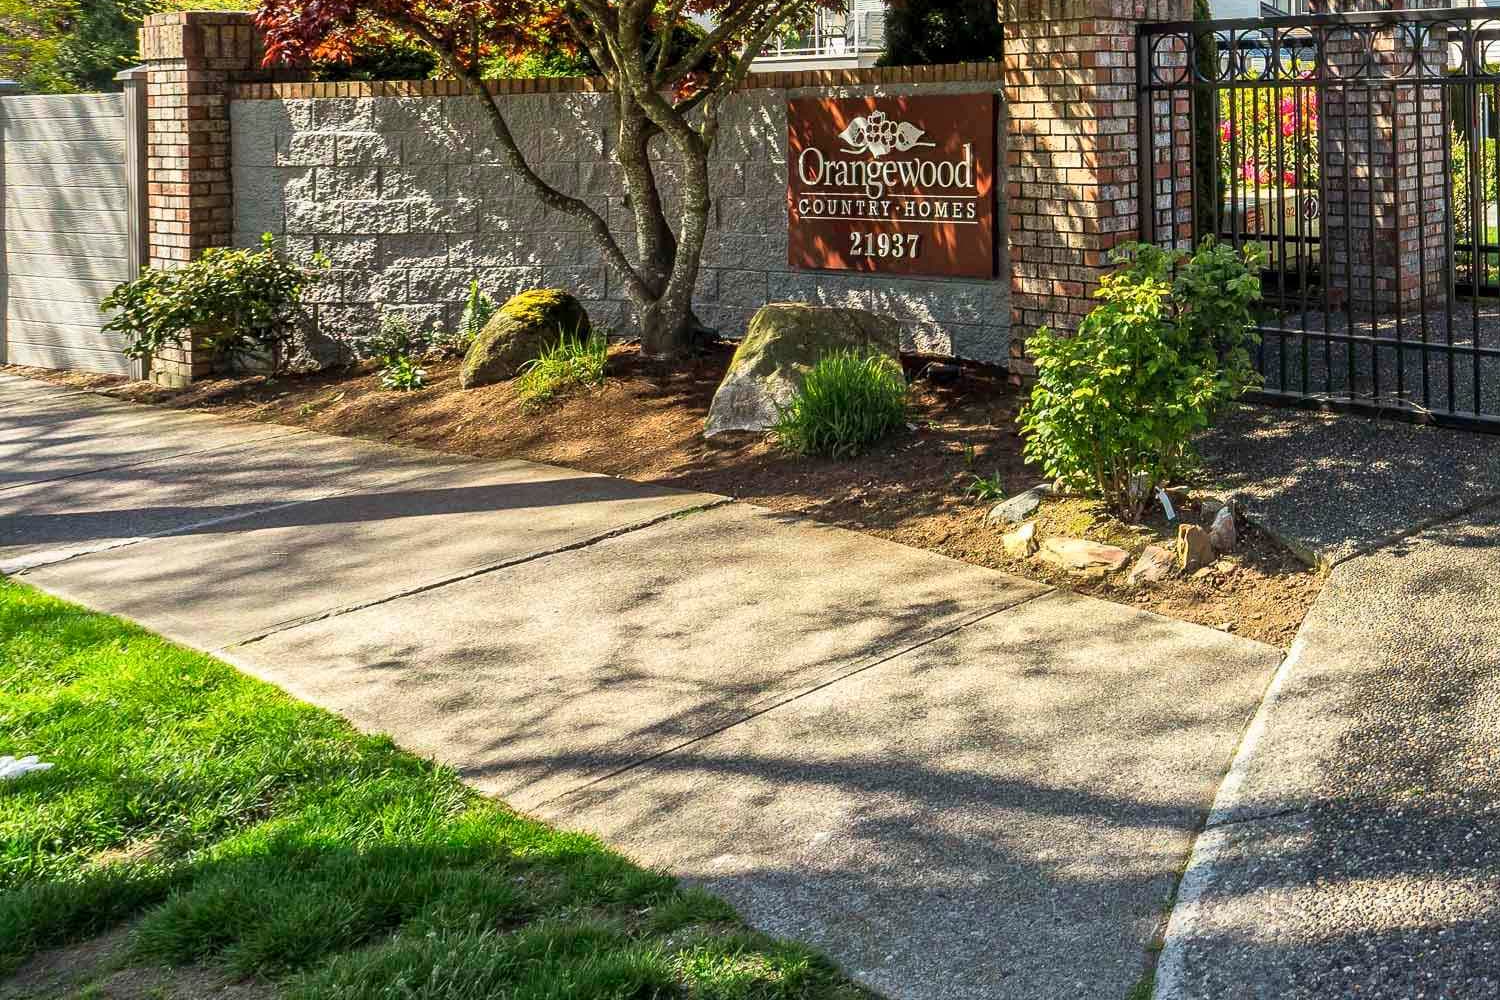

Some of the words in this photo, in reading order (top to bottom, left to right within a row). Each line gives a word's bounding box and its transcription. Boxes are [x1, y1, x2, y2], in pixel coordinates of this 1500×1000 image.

[798, 143, 975, 199] Orangewood
[798, 199, 891, 217] COUNTRY
[904, 202, 977, 219] HOMES
[850, 231, 920, 259] 21937
